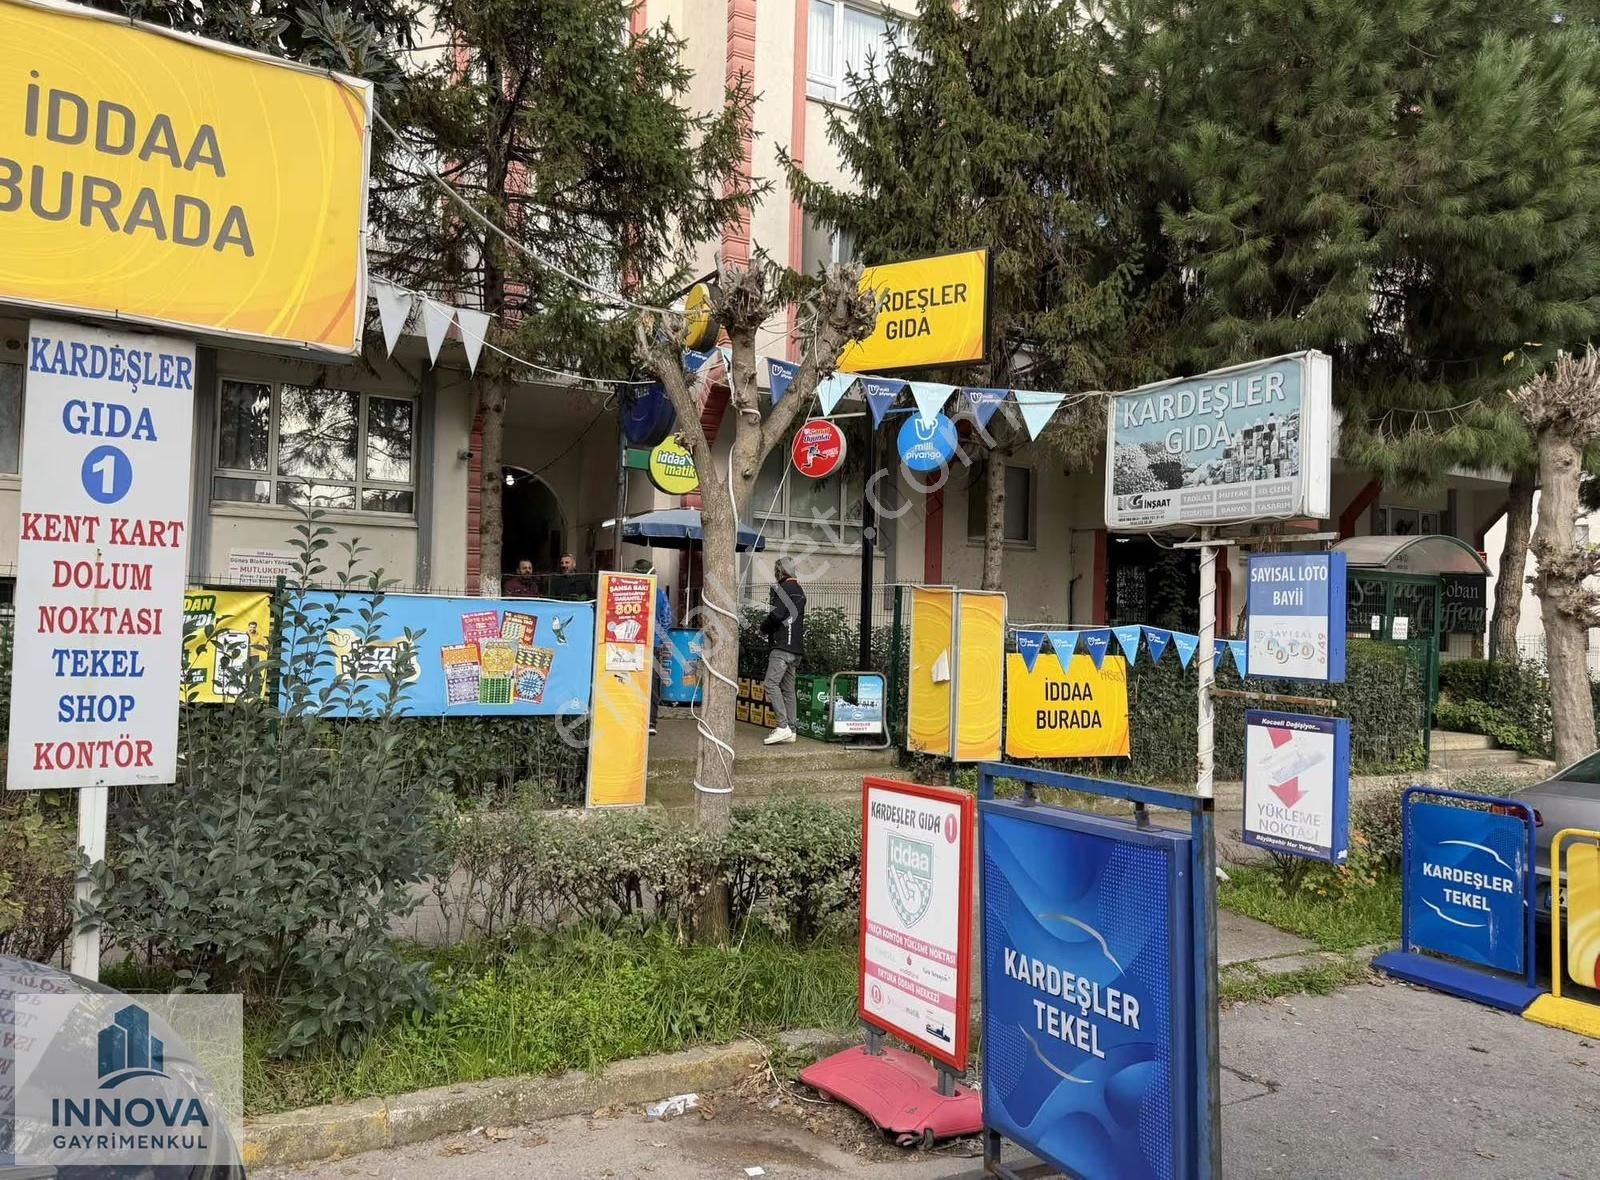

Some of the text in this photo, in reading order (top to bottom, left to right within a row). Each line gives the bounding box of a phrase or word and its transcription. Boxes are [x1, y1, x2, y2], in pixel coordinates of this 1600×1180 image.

[25, 70, 226, 178] İDDAA
[0, 157, 255, 257] BURADA
[880, 283, 967, 313] RDEŞLER
[887, 317, 930, 340] GIDA
[30, 337, 193, 393] KARDEŞLER
[1122, 370, 1286, 429] KARDEŞLER
[62, 399, 157, 442] GIDA
[914, 441, 934, 451] milli
[1164, 421, 1233, 454] GIDA
[657, 451, 686, 465] iddaa
[906, 450, 941, 460] piyango
[92, 455, 116, 495] 1
[665, 465, 696, 478] matik
[21, 513, 184, 548] KENT KART
[52, 560, 153, 591] DOLUM
[240, 566, 289, 574] MUTLUKENT
[1251, 566, 1328, 582] SAYISAL LOTO
[615, 603, 641, 616] 800
[1273, 588, 1304, 606] BAYİİ
[38, 606, 163, 635] NOKTASI
[51, 648, 145, 677] TEKEL
[1044, 677, 1093, 702] İDDAA
[58, 695, 136, 723] SHOP
[1036, 709, 1102, 730] BURADA
[33, 734, 154, 770] KONTÖR
[871, 800, 916, 829] KARDEŞLER
[919, 811, 941, 834] GIDA
[1258, 802, 1321, 827] YÜKLEME
[1258, 818, 1319, 842] NOKTASI
[1422, 862, 1514, 894] KARDEŞLER
[1443, 888, 1492, 912] TEKEL
[1004, 947, 1141, 1030] KARDEŞLER
[1033, 998, 1106, 1060] TEKEL
